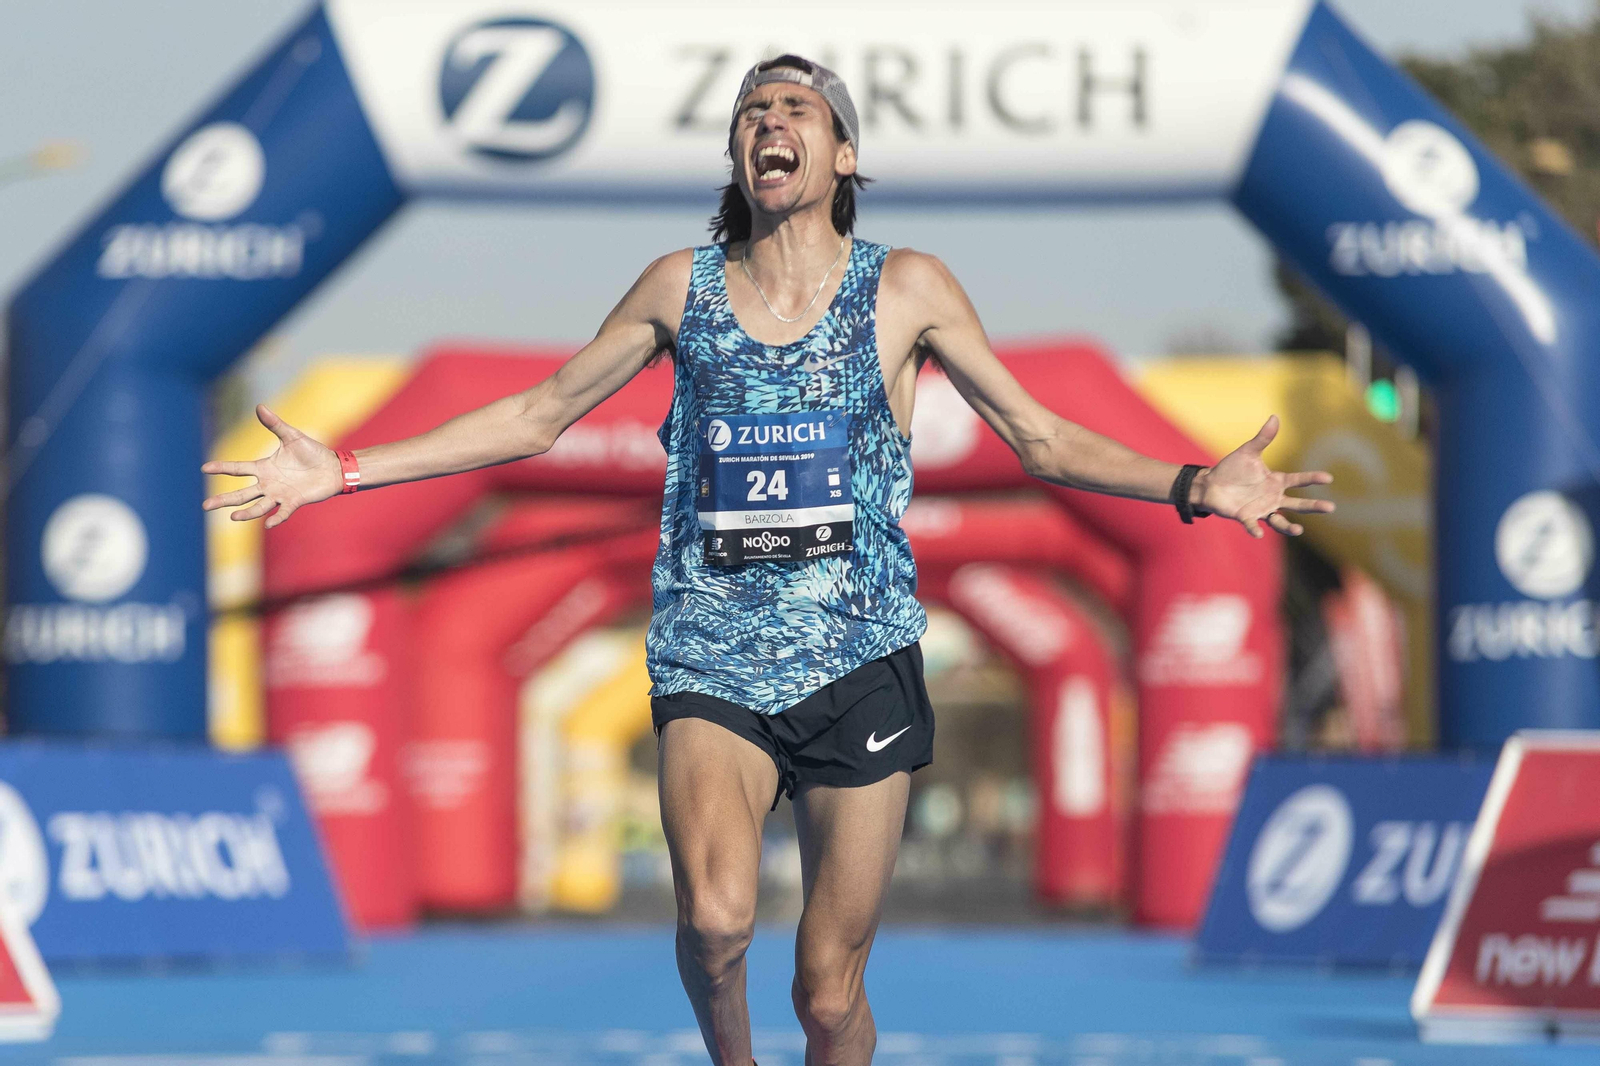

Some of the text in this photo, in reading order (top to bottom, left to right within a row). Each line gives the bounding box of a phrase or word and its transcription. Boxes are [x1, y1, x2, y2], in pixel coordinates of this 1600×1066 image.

[671, 40, 1154, 134] ZRICH
[737, 421, 826, 445] ZURICH
[741, 454, 769, 462] MARATÓN
[779, 453, 800, 461] SEVILLA
[800, 452, 815, 460] 2019
[746, 469, 789, 502] 24
[830, 489, 842, 498] XS
[745, 513, 794, 525] BARZOLA
[805, 542, 845, 558] ZURICH
[1352, 821, 1474, 908] ZU
